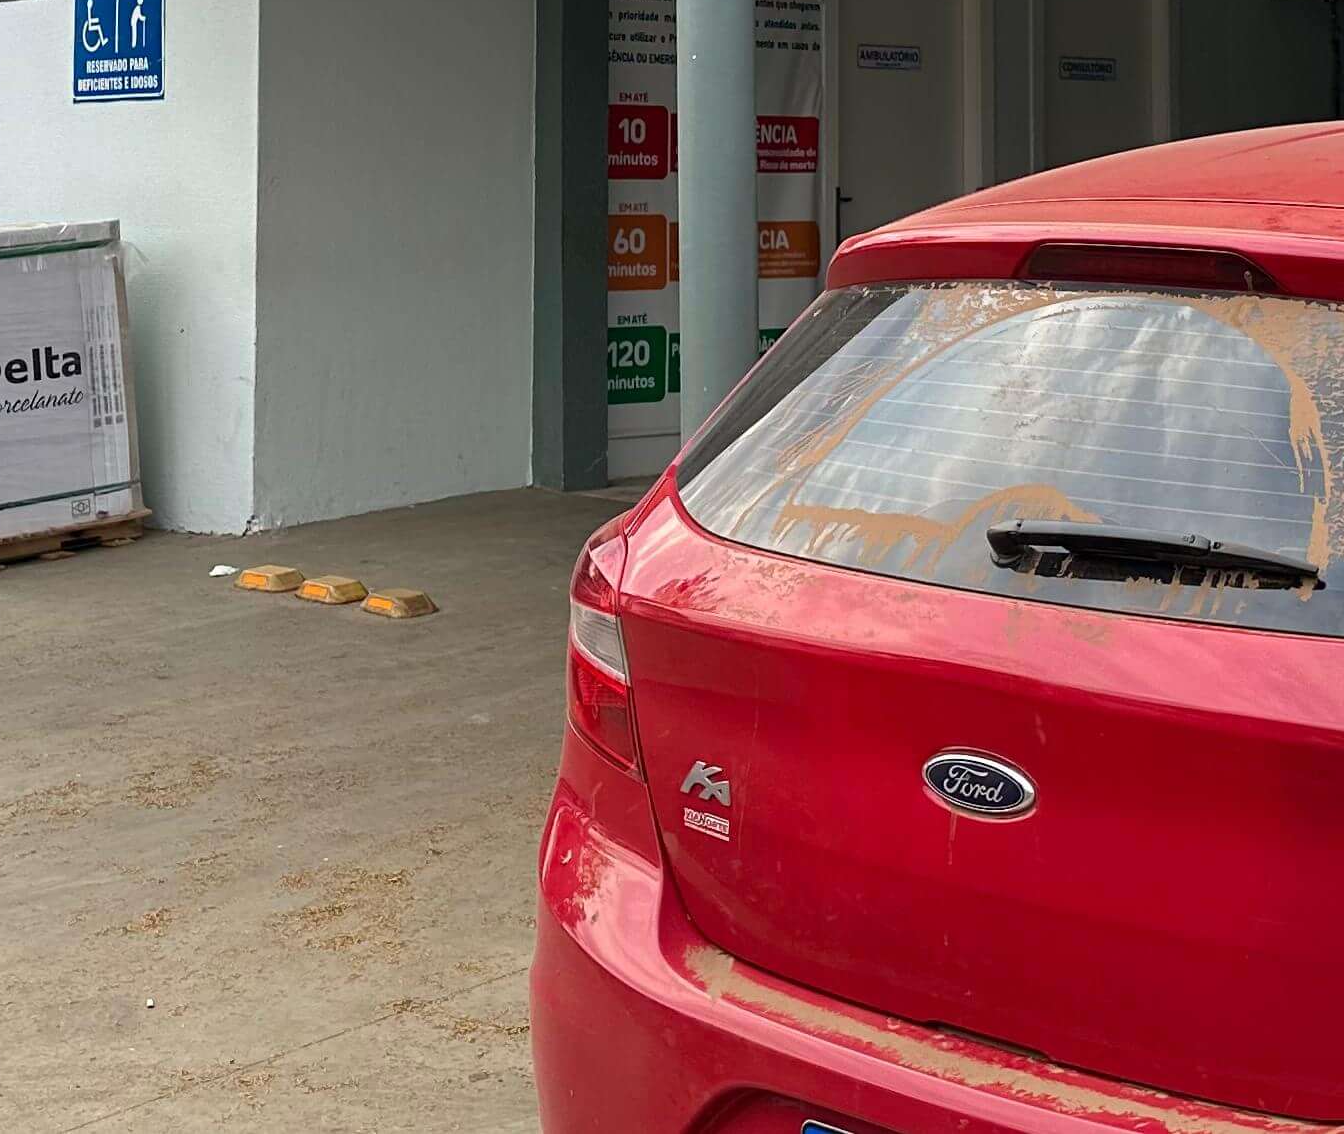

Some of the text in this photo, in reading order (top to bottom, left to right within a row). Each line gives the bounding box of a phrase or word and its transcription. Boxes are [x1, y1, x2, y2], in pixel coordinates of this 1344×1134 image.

[86, 56, 149, 74] RESERVADO PARA
[78, 74, 158, 92] DEFICIENTES E IDOSOS
[618, 118, 646, 144] 10
[608, 150, 658, 166] minutos
[613, 228, 646, 254] 60
[608, 262, 656, 278] minutos
[608, 340, 650, 368] 120
[943, 764, 1004, 803] Ford
